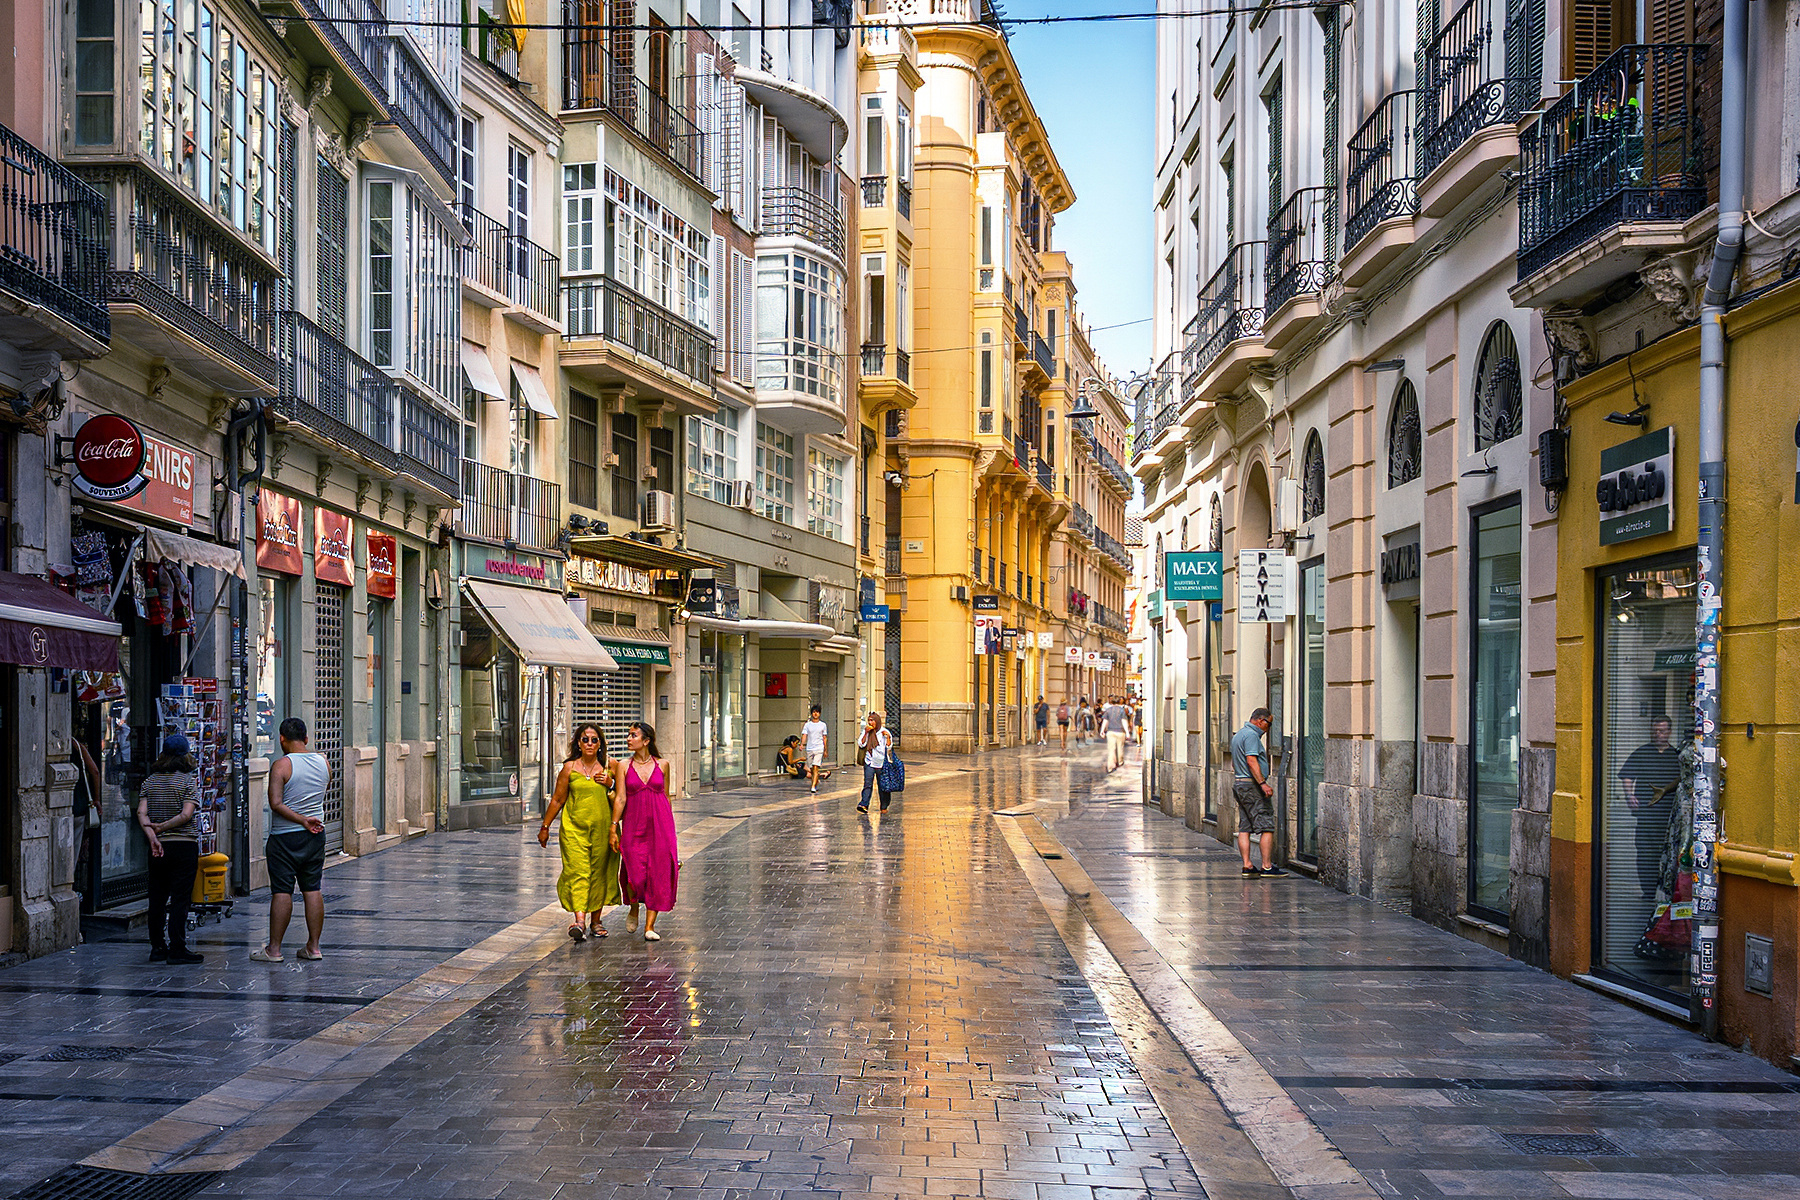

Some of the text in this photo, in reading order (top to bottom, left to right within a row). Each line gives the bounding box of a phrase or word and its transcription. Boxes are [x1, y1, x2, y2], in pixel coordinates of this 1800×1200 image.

[79, 438, 136, 461] Coca-Cola
[143, 441, 192, 490] ENIRS
[89, 484, 131, 497] SOUVENIRS
[1173, 561, 1218, 576] MAEX
[1381, 543, 1420, 584] PAYMA
[1256, 552, 1270, 622] PAYMA
